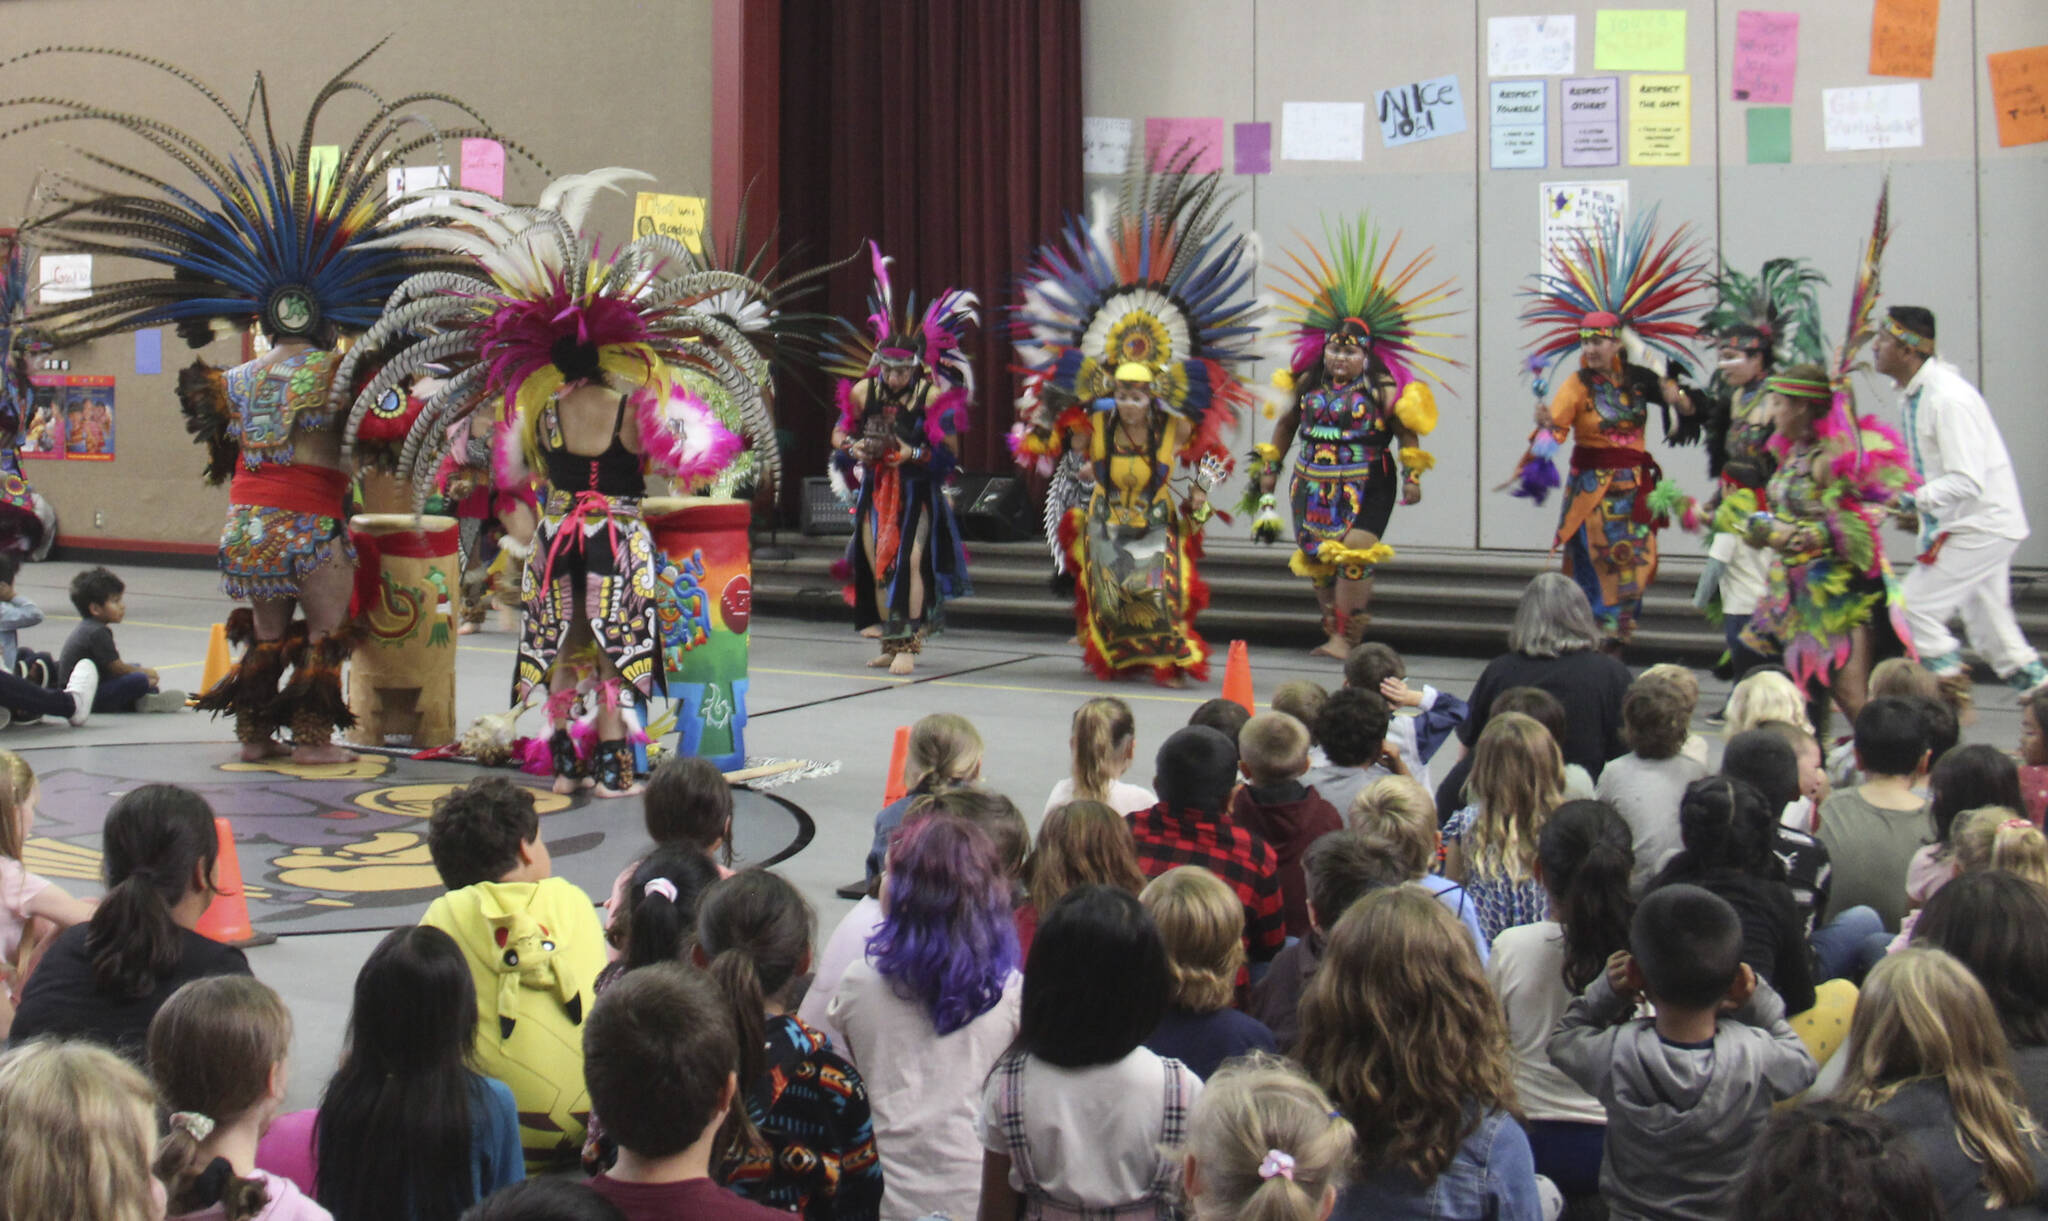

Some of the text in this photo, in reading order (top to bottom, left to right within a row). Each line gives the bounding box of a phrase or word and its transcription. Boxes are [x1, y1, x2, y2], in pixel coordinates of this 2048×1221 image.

[1499, 89, 1539, 99] RESPECT
[1568, 86, 1610, 96] RESPECT
[1639, 84, 1681, 94] RESPECT
[1496, 104, 1541, 114] YOURSELF
[1570, 101, 1608, 111] OTHERS
